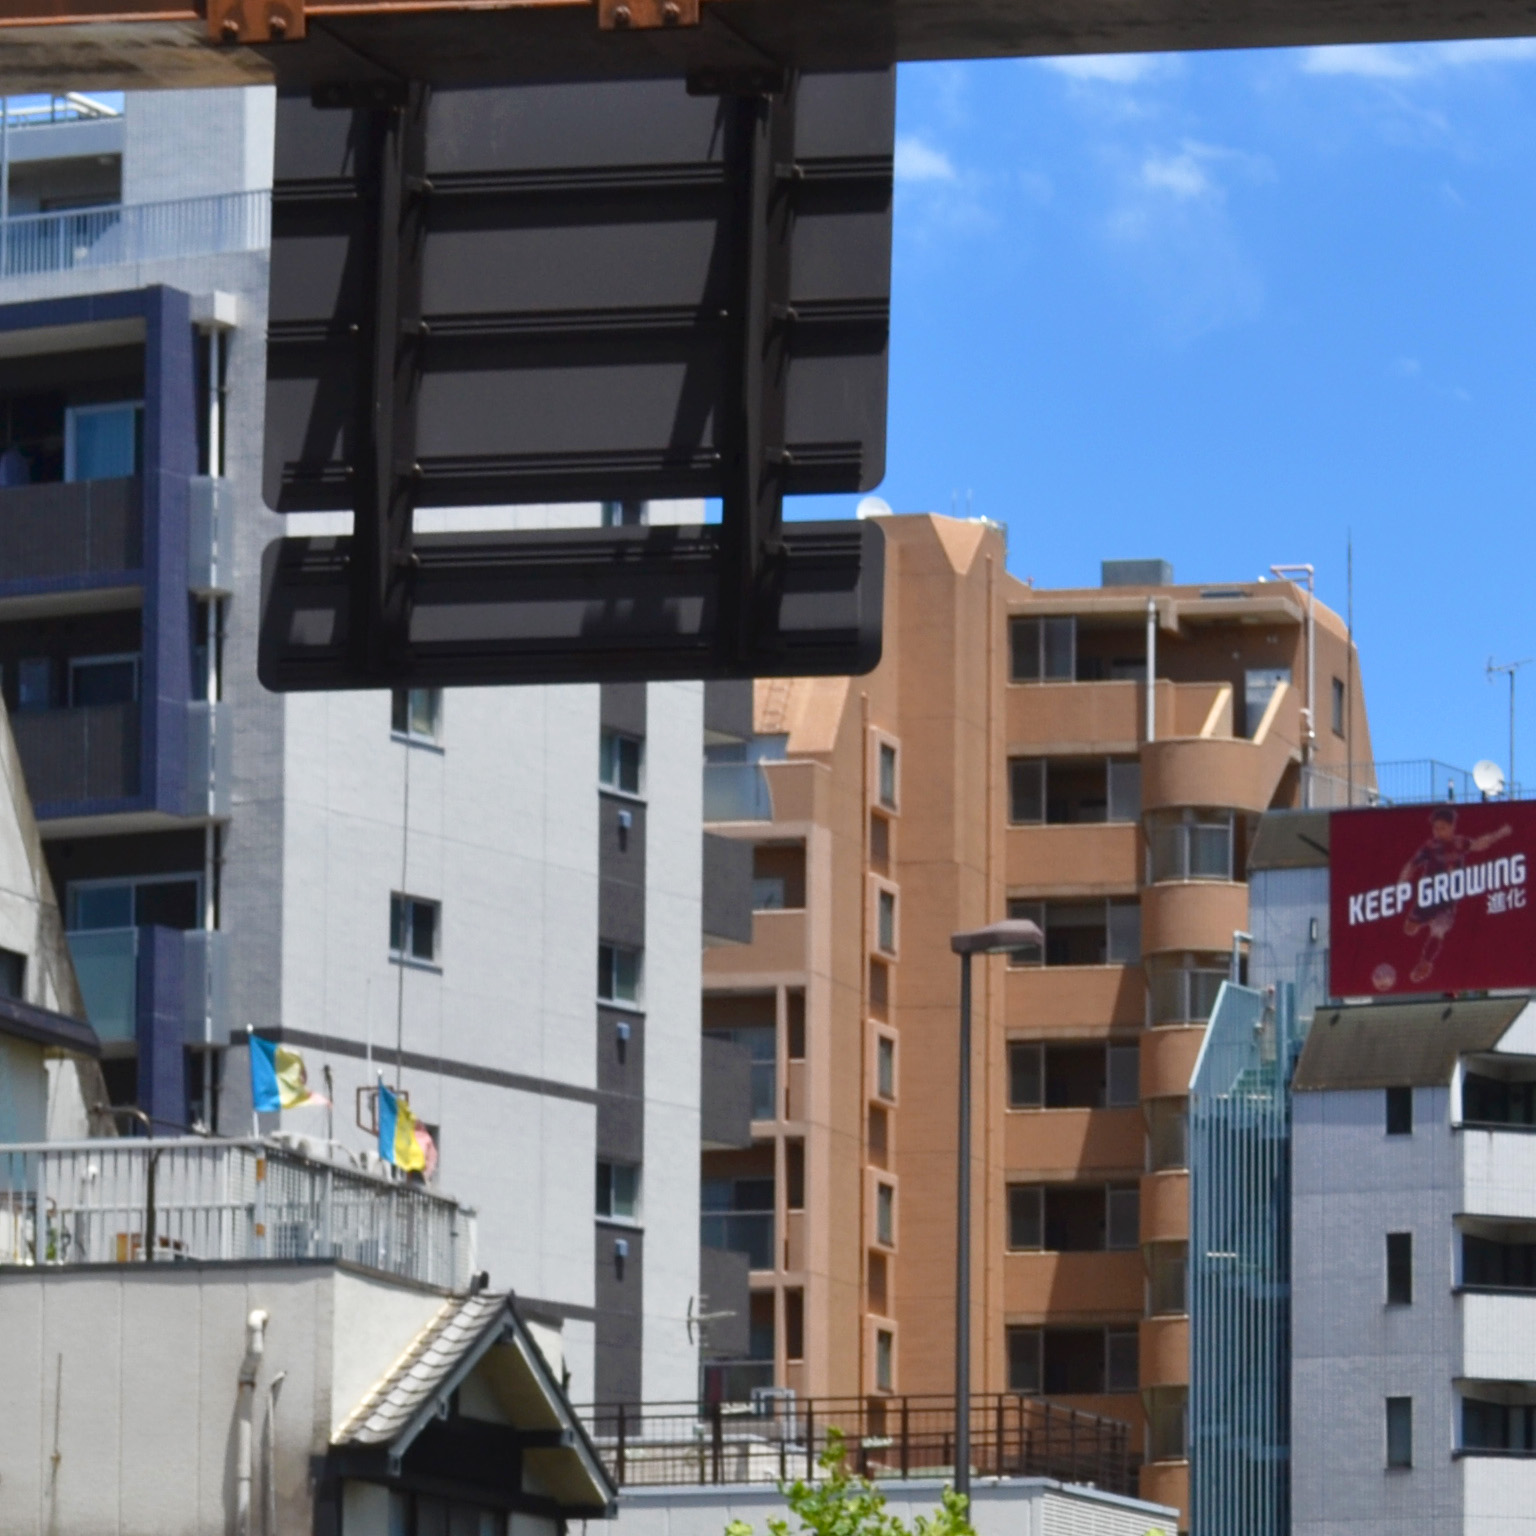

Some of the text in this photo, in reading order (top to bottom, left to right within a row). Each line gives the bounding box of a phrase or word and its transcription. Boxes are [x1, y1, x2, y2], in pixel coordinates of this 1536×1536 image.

[1348, 852, 1527, 926] KEEP GROWING
[1486, 889, 1527, 915] 進化
